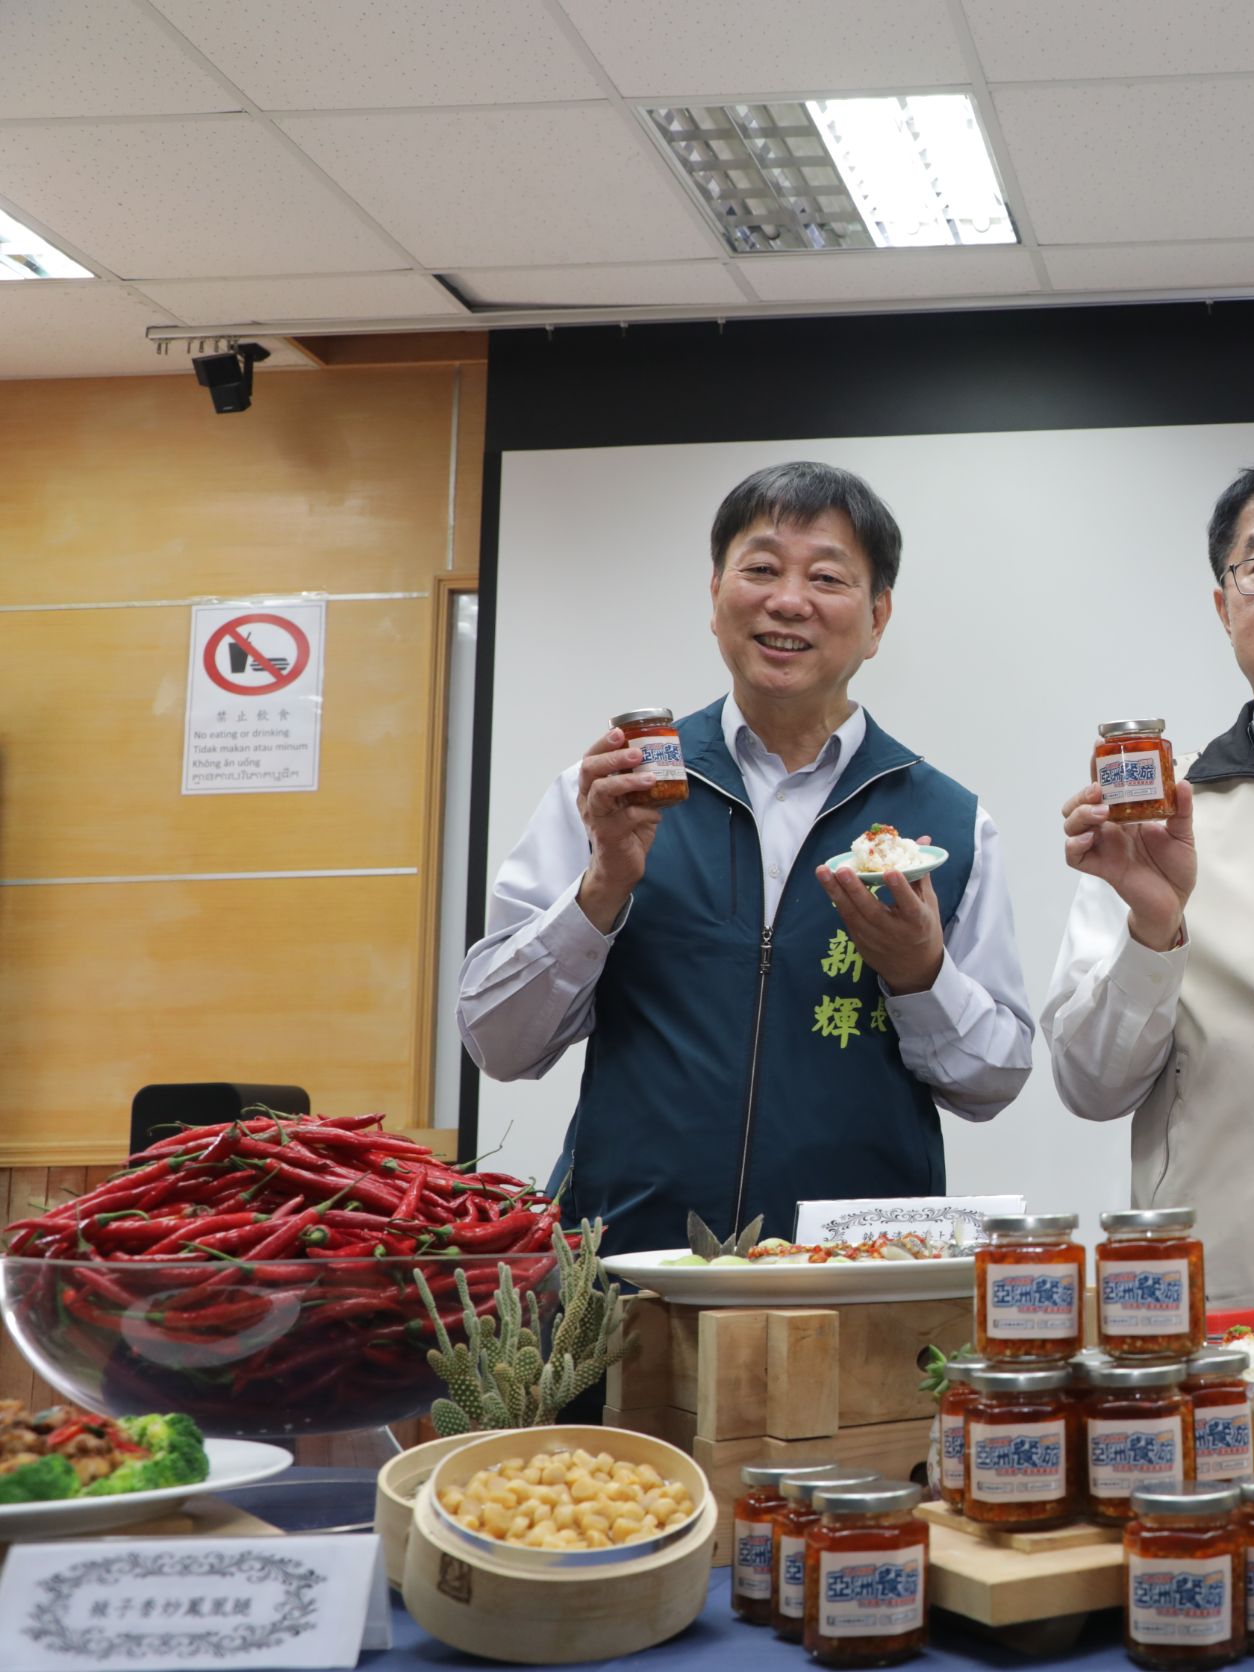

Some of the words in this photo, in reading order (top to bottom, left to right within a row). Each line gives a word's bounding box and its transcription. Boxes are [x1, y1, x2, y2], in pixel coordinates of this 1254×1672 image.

[217, 708, 290, 722] 禁止飲食
[194, 731, 208, 740] No
[209, 730, 238, 740] eating
[240, 730, 250, 738] or
[252, 728, 290, 738] drinking
[194, 744, 217, 754] Tidak
[219, 744, 251, 753] makan
[252, 743, 273, 752] atau
[275, 743, 308, 751] minum
